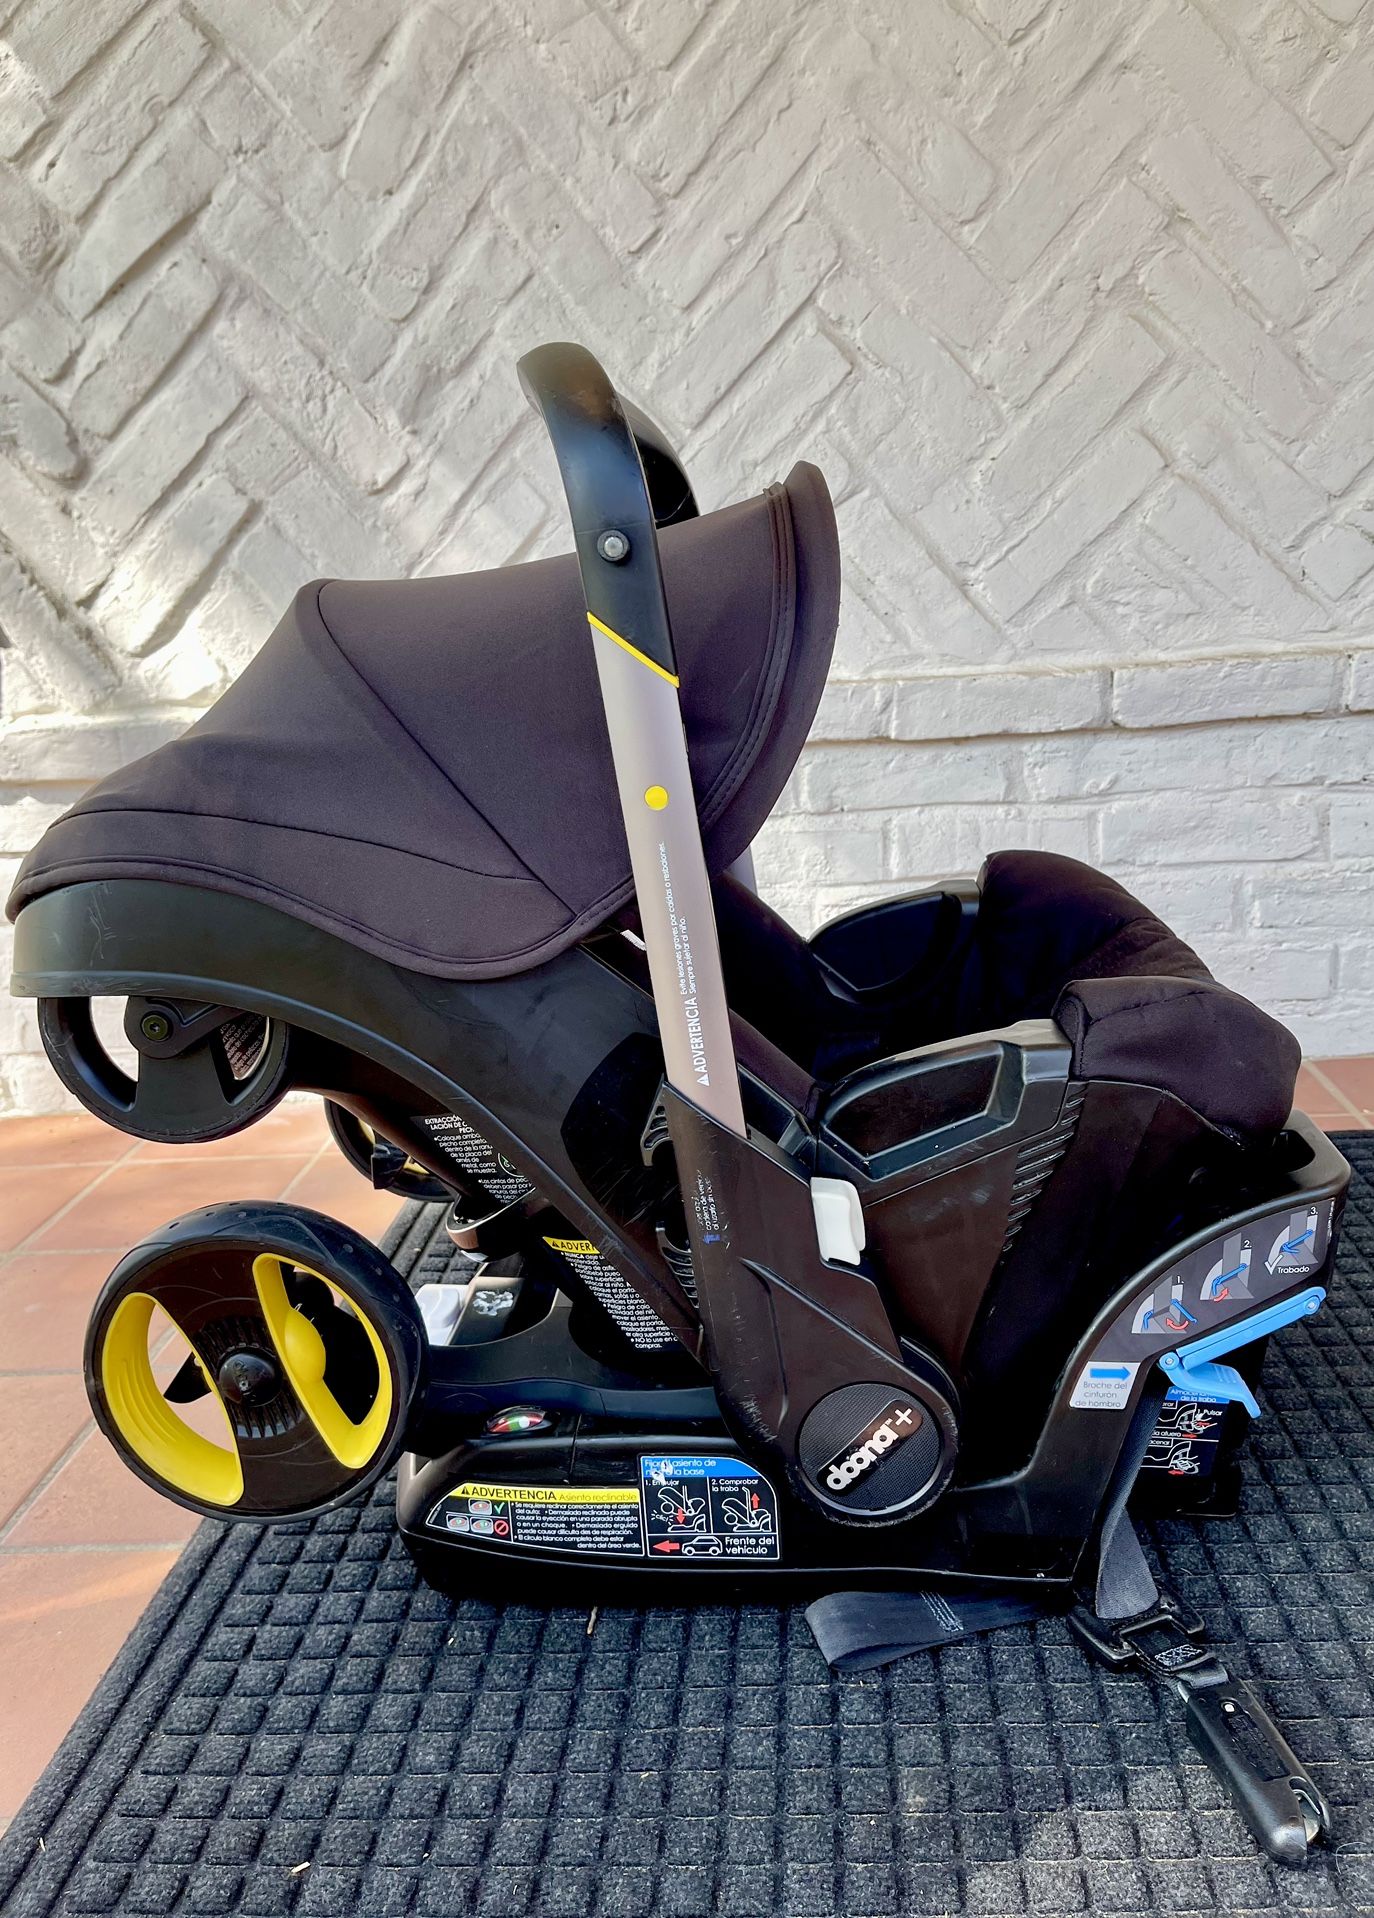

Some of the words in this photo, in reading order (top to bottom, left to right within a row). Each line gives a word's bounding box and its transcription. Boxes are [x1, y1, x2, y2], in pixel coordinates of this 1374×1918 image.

[665, 888, 675, 912] caídas
[670, 913, 678, 926] por
[679, 916, 687, 934] niño.
[672, 926, 682, 950] graves
[681, 934, 689, 942] al
[683, 943, 693, 965] sujetar
[676, 951, 685, 978] lesiones
[687, 966, 697, 994] Siempre
[679, 979, 688, 995] Evite
[685, 996, 708, 1073] ADVERTENCIA
[430, 1121, 453, 1130] LACIÓN
[439, 1140, 458, 1148] pecho
[458, 1139, 488, 1147] completa
[465, 1150, 483, 1158] placa
[1310, 1206, 1319, 1215] 3.
[1244, 1240, 1252, 1248] 2.
[1277, 1265, 1310, 1274] Trabado
[1177, 1276, 1185, 1284] 1.
[1083, 1381, 1112, 1389] Broche
[1113, 1381, 1128, 1389] del
[1088, 1400, 1121, 1408] hombro
[672, 1459, 703, 1467] asiento
[703, 1459, 716, 1467] de
[683, 1468, 705, 1476] base
[652, 1479, 680, 1487] Emujar
[719, 1478, 759, 1486] Comprobar
[471, 1486, 557, 1501] ADVERTENCIA
[559, 1493, 591, 1501] Asiento
[592, 1493, 637, 1501] reclinable
[613, 1522, 638, 1530] erguido
[724, 1536, 757, 1545] Frente
[758, 1536, 775, 1545] del
[725, 1545, 768, 1555] vehículo
